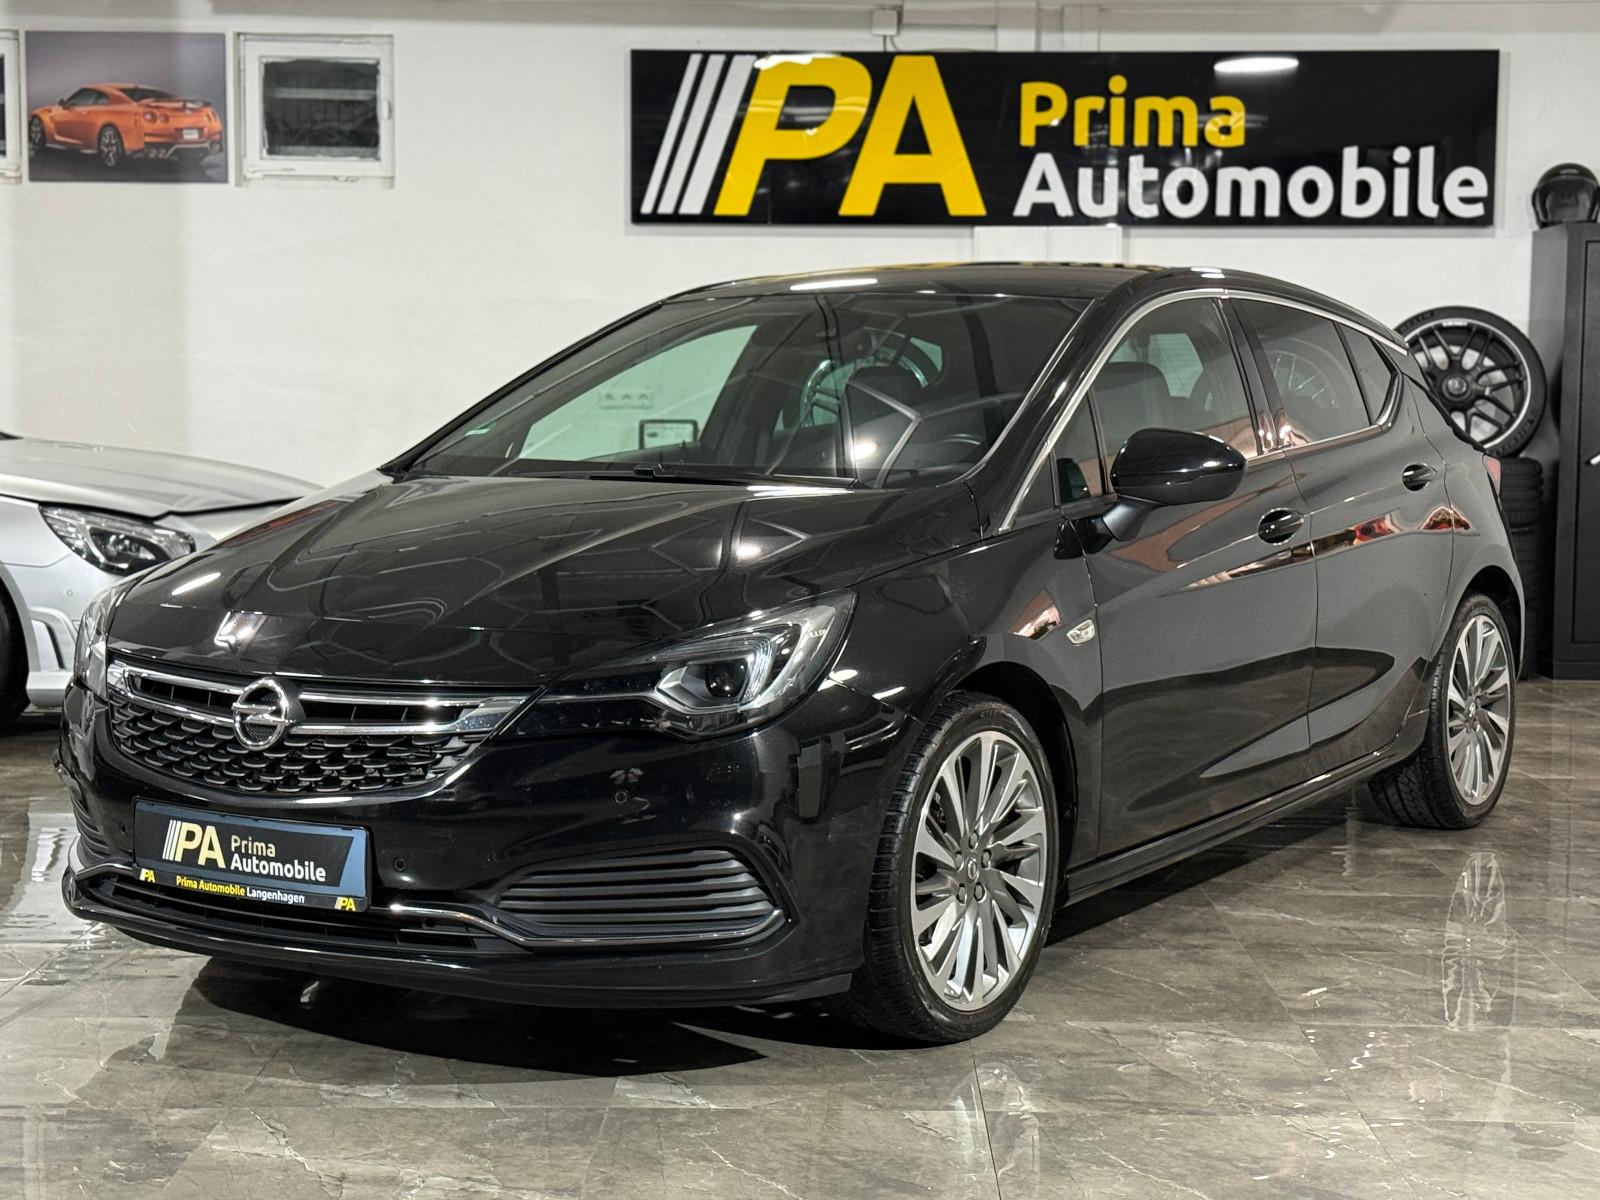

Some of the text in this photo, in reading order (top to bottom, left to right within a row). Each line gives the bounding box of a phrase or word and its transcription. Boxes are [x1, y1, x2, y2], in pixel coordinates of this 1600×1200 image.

[1019, 74, 1246, 148] Prima
[712, 53, 987, 217] PA
[1012, 145, 1489, 219] Automobile
[174, 821, 226, 869] PA
[230, 834, 276, 858] Prima
[142, 868, 156, 884] PA
[230, 853, 327, 882] Automobile
[176, 875, 305, 905] Prima Automobile Langenhagen
[338, 896, 356, 912] PA
